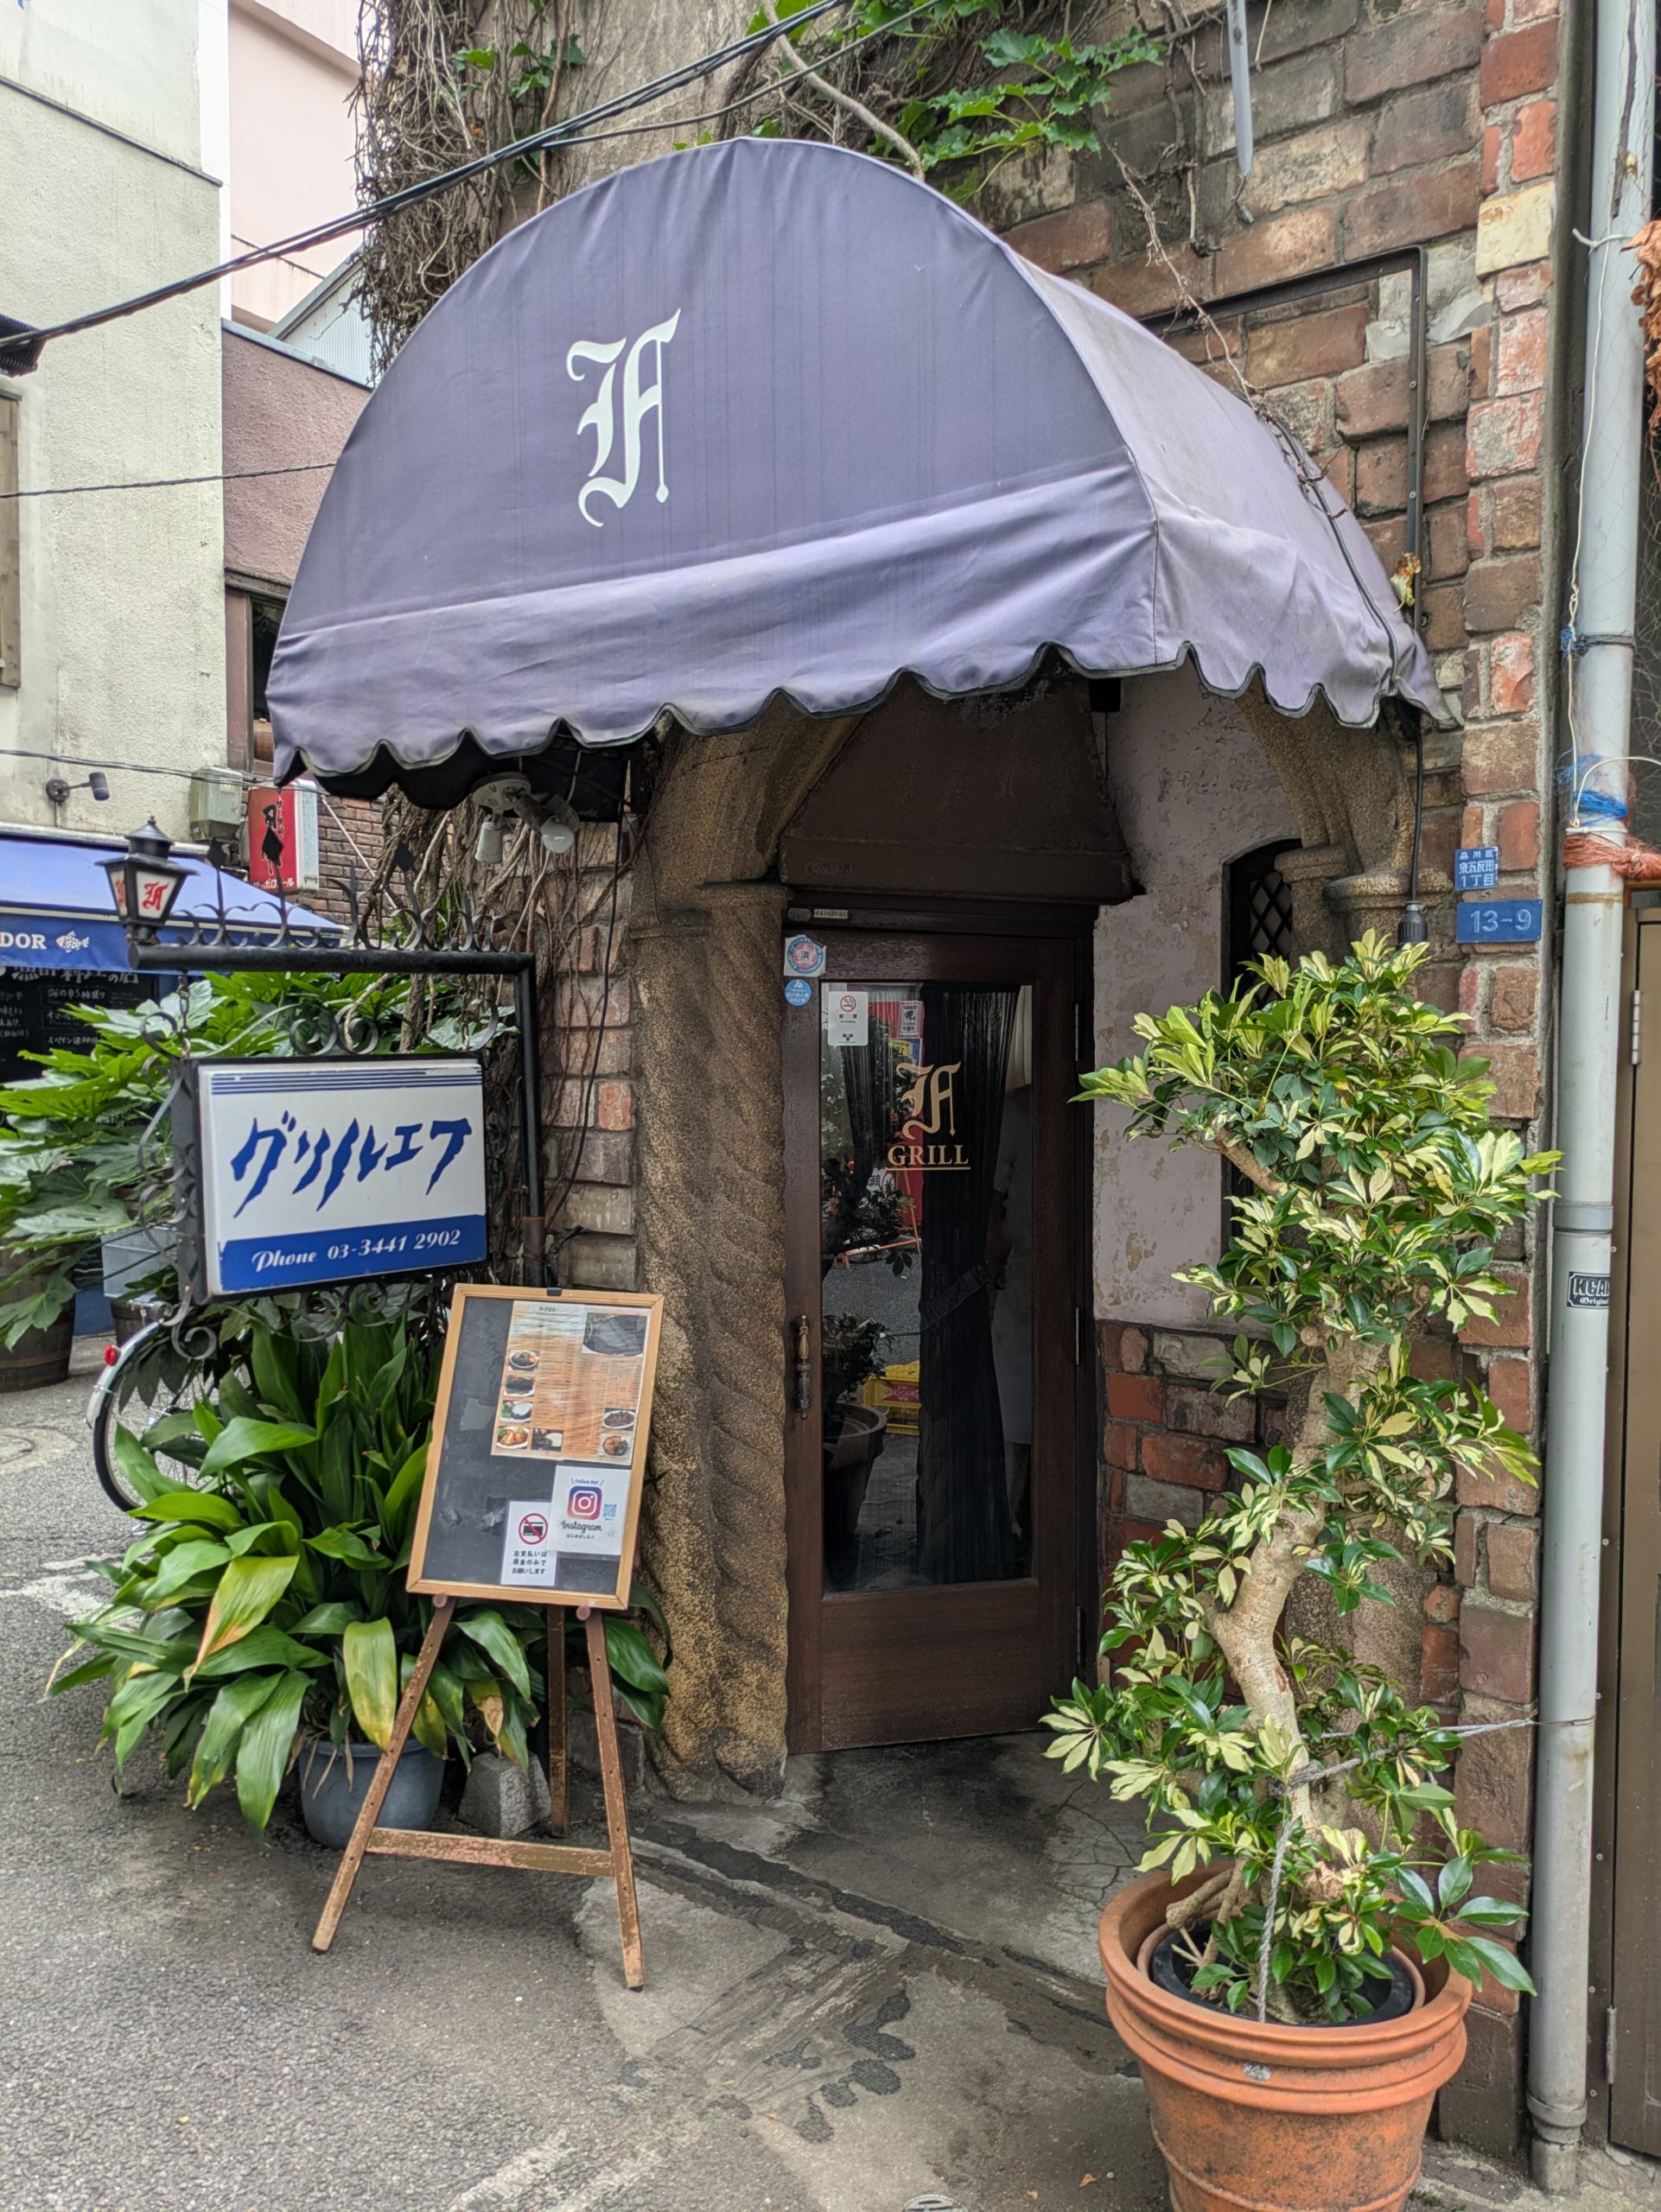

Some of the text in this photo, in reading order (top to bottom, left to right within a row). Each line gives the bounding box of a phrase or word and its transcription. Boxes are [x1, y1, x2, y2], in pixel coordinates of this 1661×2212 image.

[1459, 849, 1494, 861] 品川区
[1459, 860, 1495, 874] 東五反田
[1461, 873, 1494, 888] 1丁目
[1470, 908, 1532, 934] 13-9
[0, 931, 48, 950] DOR
[230, 1109, 473, 1219] グリルエフ
[888, 1145, 969, 1166] GRILL
[251, 1229, 461, 1273] Phone 03-3441 2902
[560, 1520, 602, 1534] Instagram
